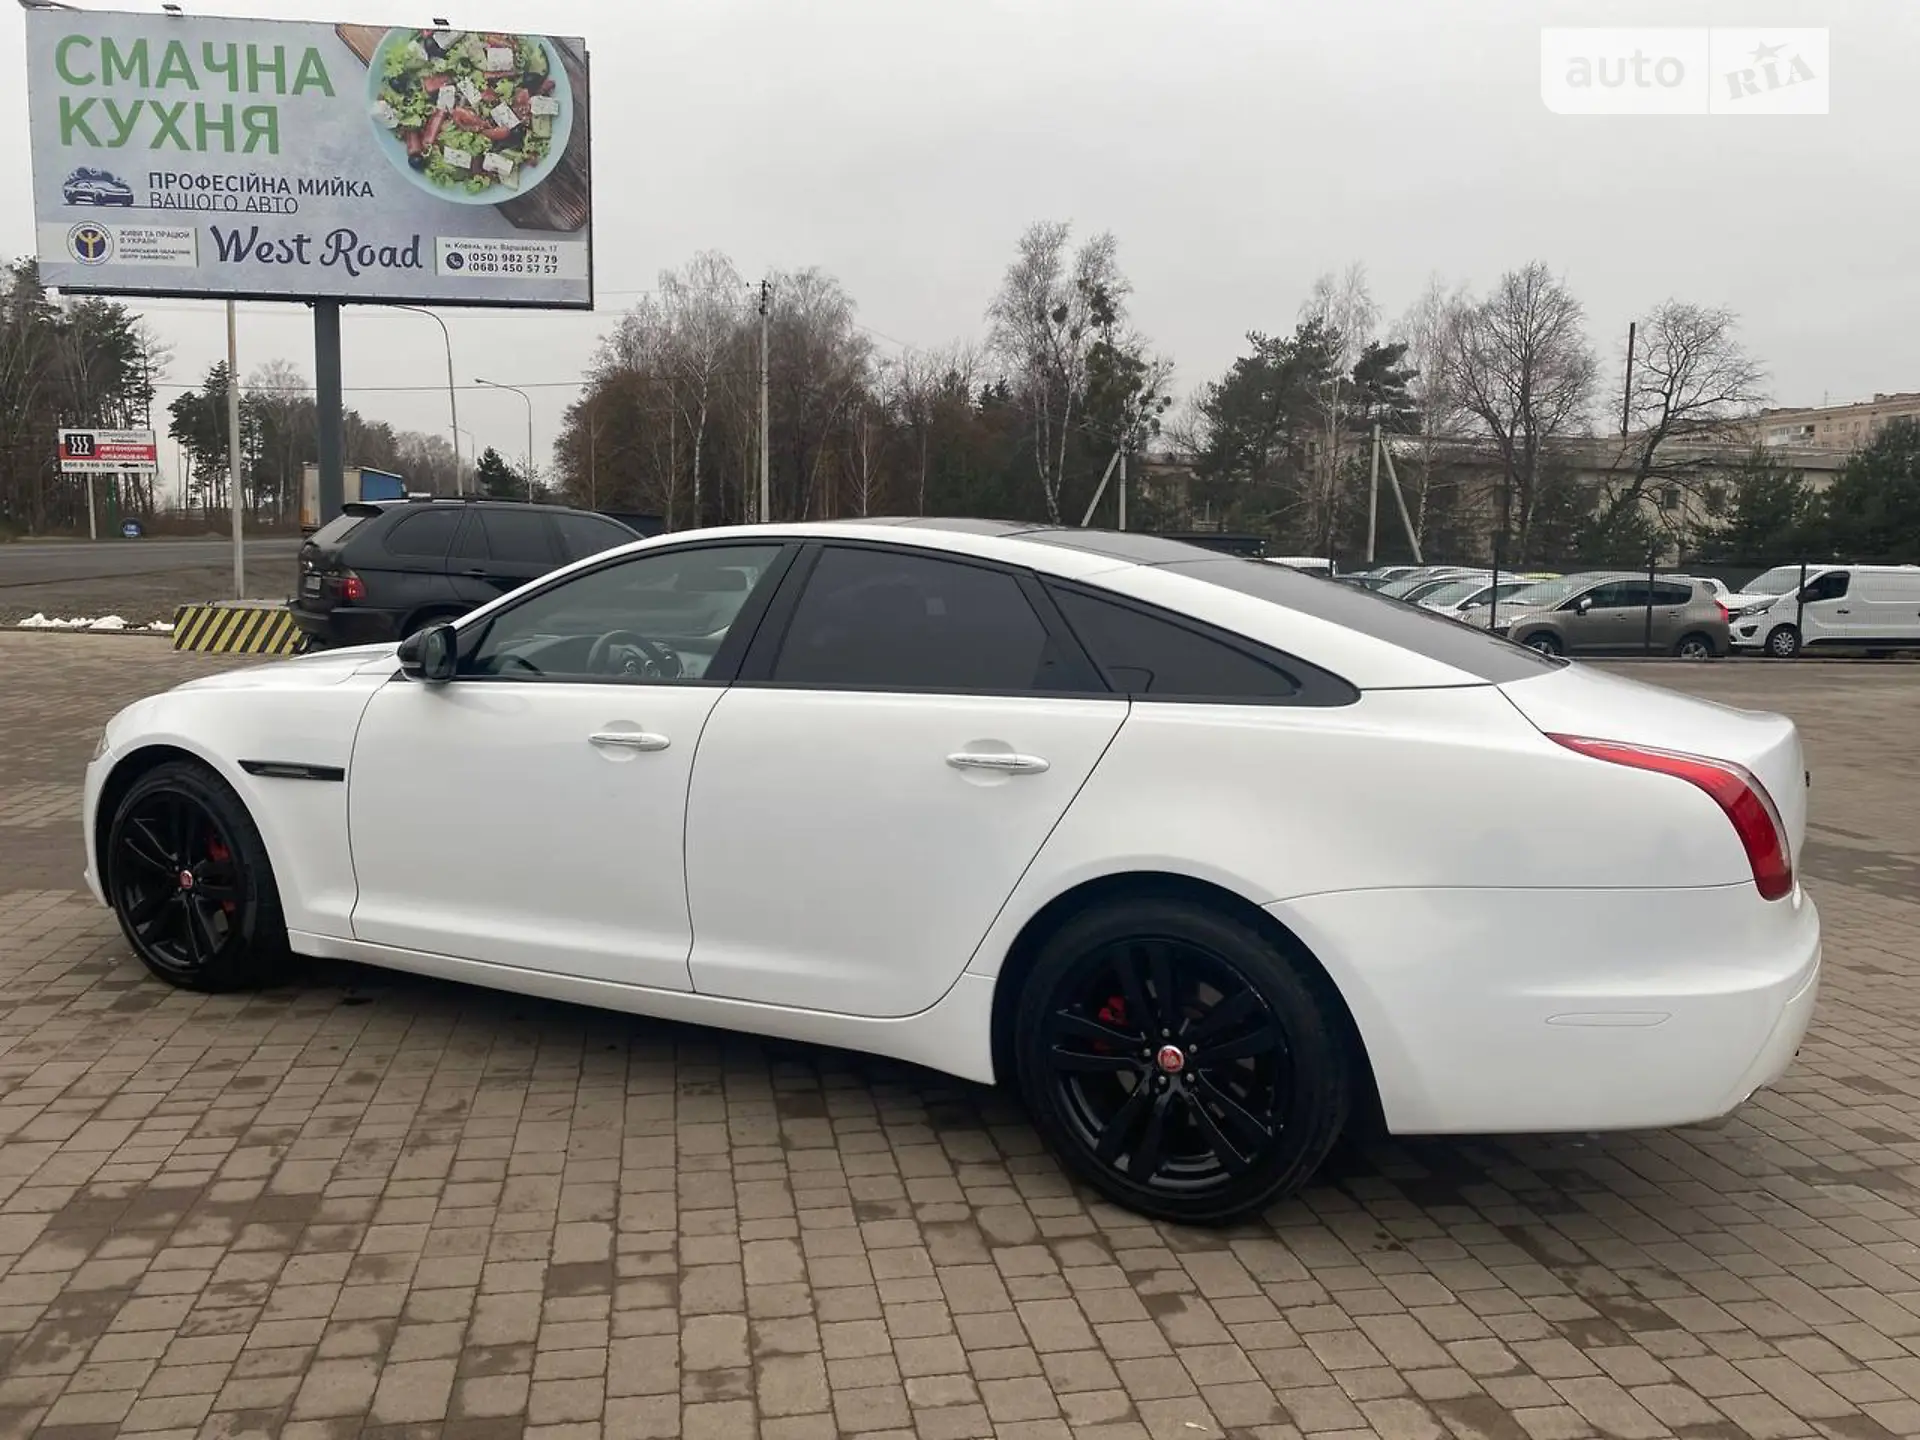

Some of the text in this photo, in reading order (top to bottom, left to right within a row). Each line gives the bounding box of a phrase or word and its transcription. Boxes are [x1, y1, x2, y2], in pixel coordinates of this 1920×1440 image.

[55, 34, 336, 97] СМАЧНА
[59, 96, 279, 155] КУХНЯ
[149, 172, 374, 198] ПРОФЕСІЙНА МИЙКА
[150, 191, 299, 214] ВАШОГО АВТО
[210, 225, 423, 277] West Road
[468, 253, 558, 264] (050) 982 57 79
[468, 263, 558, 274] (068) 450 57 57
